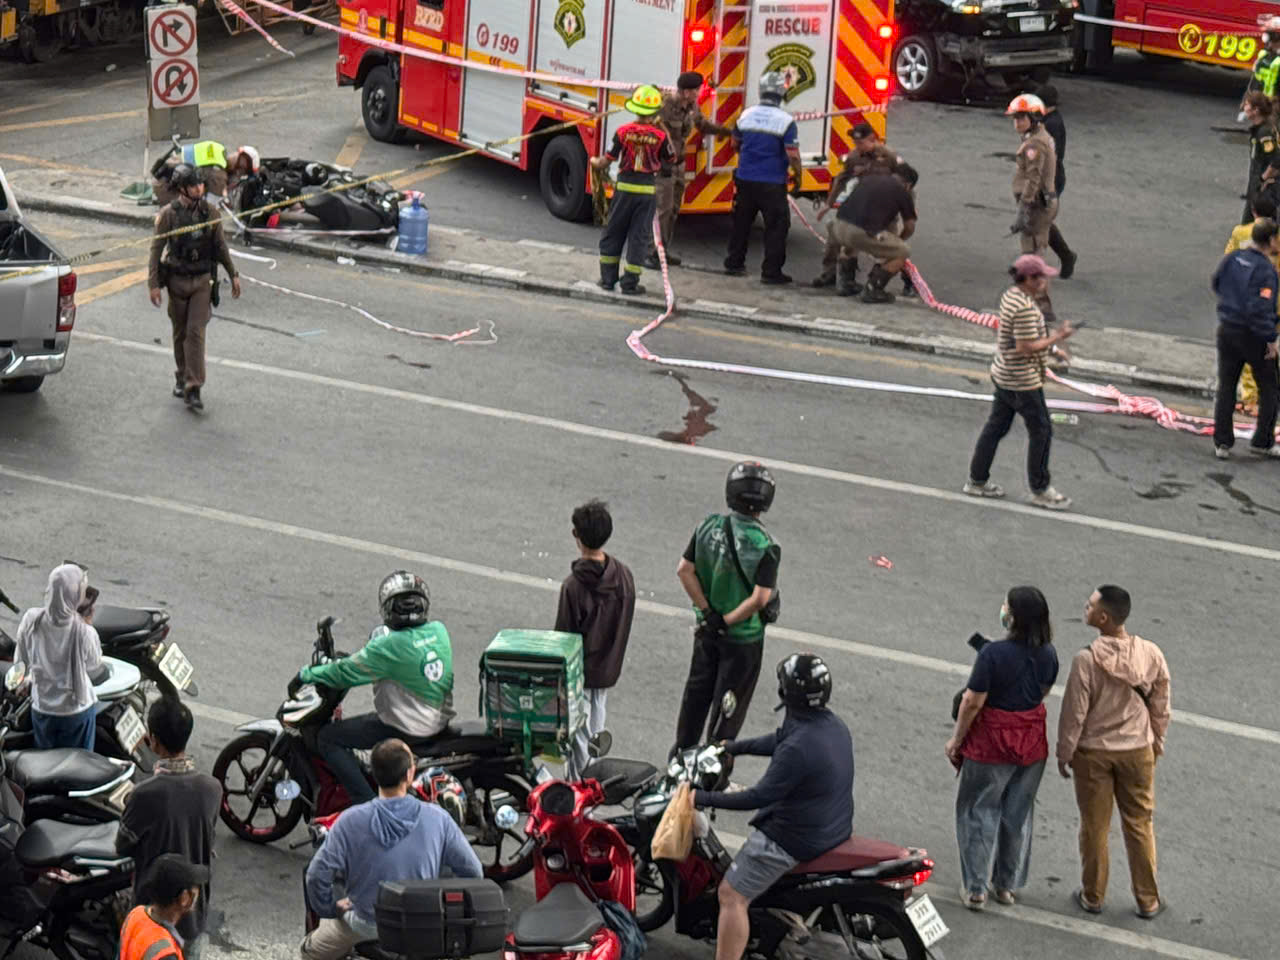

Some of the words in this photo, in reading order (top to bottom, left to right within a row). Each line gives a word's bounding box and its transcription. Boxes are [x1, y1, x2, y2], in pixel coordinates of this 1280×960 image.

[765, 17, 821, 36] RESCUE
[492, 32, 519, 55] 199
[1204, 33, 1257, 62] 199
